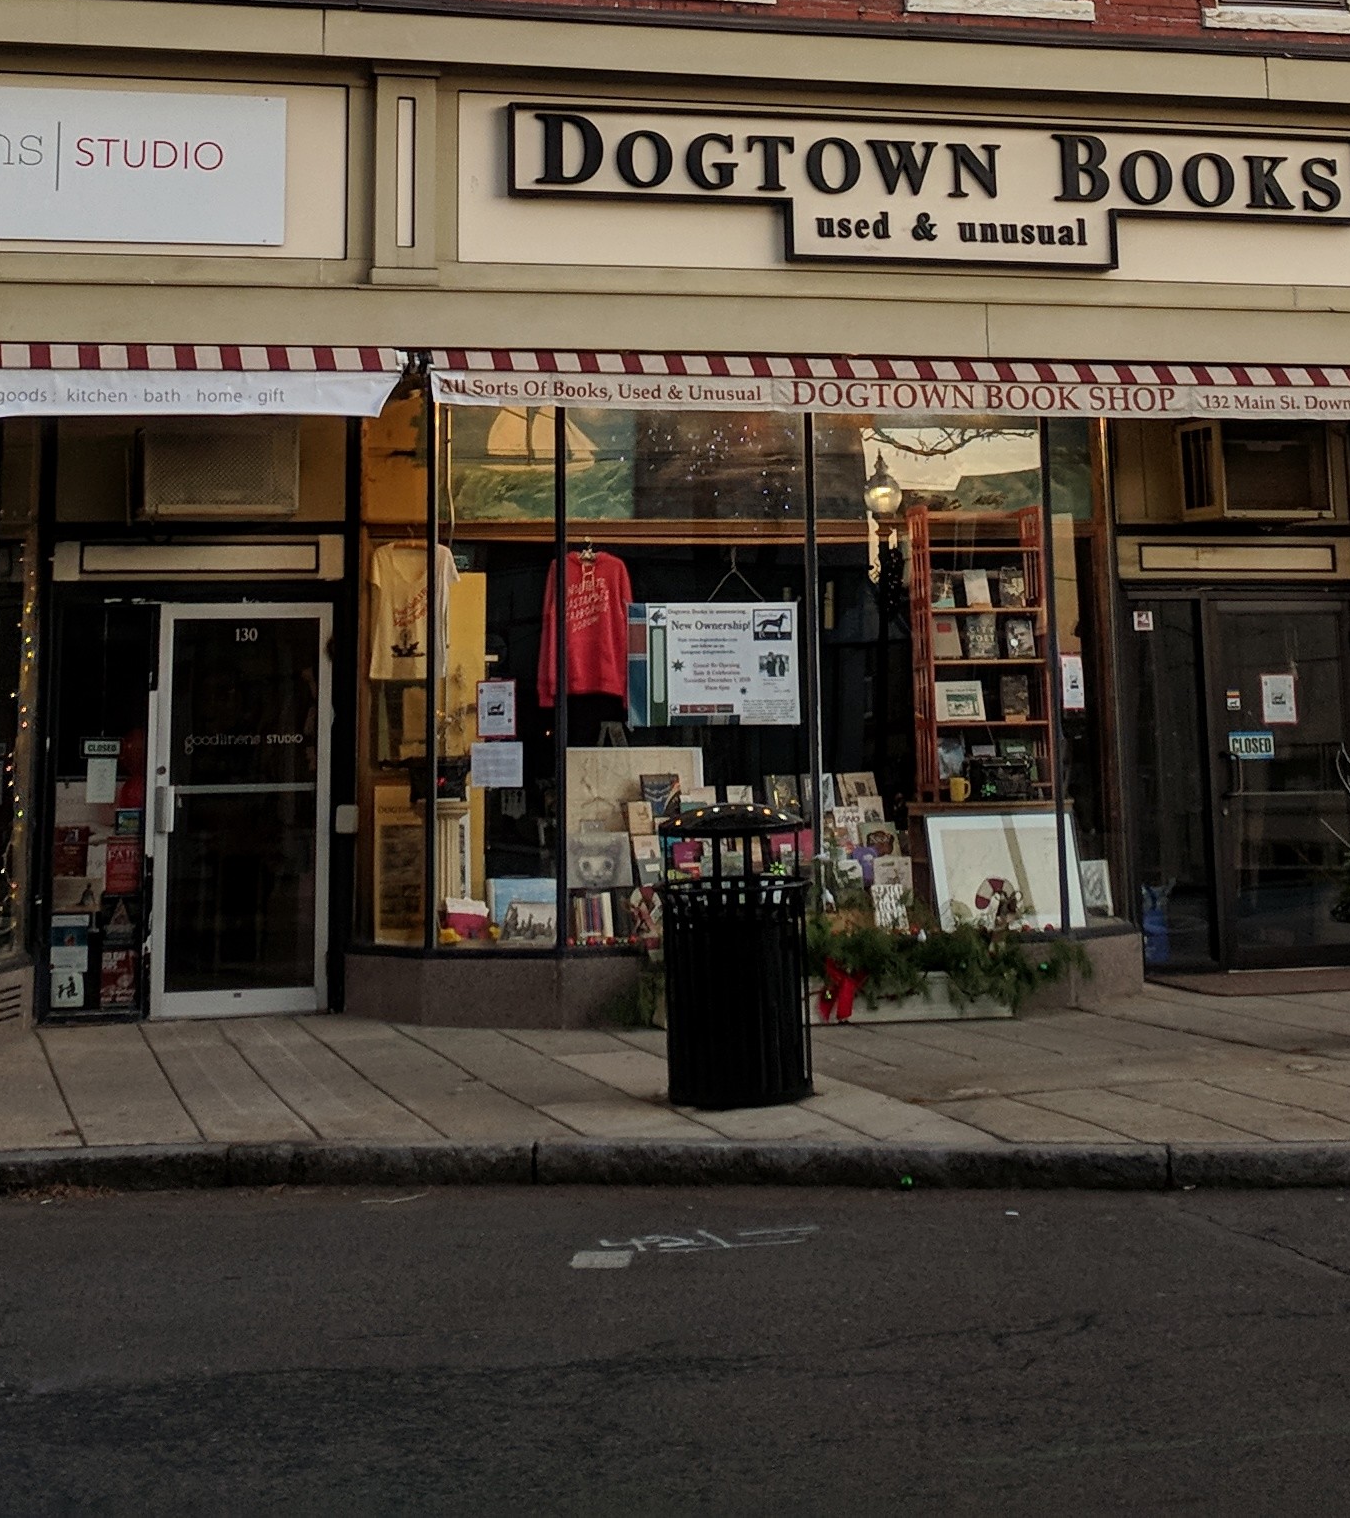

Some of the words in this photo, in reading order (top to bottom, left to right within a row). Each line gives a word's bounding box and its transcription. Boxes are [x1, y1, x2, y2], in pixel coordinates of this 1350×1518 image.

[74, 135, 225, 172] STUDIO
[815, 210, 892, 242] used
[910, 212, 940, 241] &
[957, 215, 1088, 247] unusual
[66, 386, 128, 403] kitchen
[143, 388, 181, 403] bath
[196, 388, 243, 403] home
[257, 388, 285, 406] gift
[439, 379, 467, 394] All
[472, 380, 519, 396] Sorts
[524, 380, 549, 397] Of
[553, 382, 613, 401] Books,
[617, 383, 661, 400] Used
[666, 384, 683, 400] &
[688, 384, 762, 401] Unusual
[791, 380, 975, 409] DOGTOWN
[985, 384, 1081, 411] BOOK
[1088, 385, 1175, 412] SHOP
[1204, 394, 1231, 410] 132
[1234, 394, 1276, 410] Main
[1279, 395, 1300, 410] St.
[235, 627, 259, 642] 130
[671, 620, 692, 631] New
[87, 744, 118, 752] CLOSED
[184, 733, 262, 755] goodlinens
[266, 733, 304, 745] STUDIO
[1231, 737, 1273, 754] CLOSED
